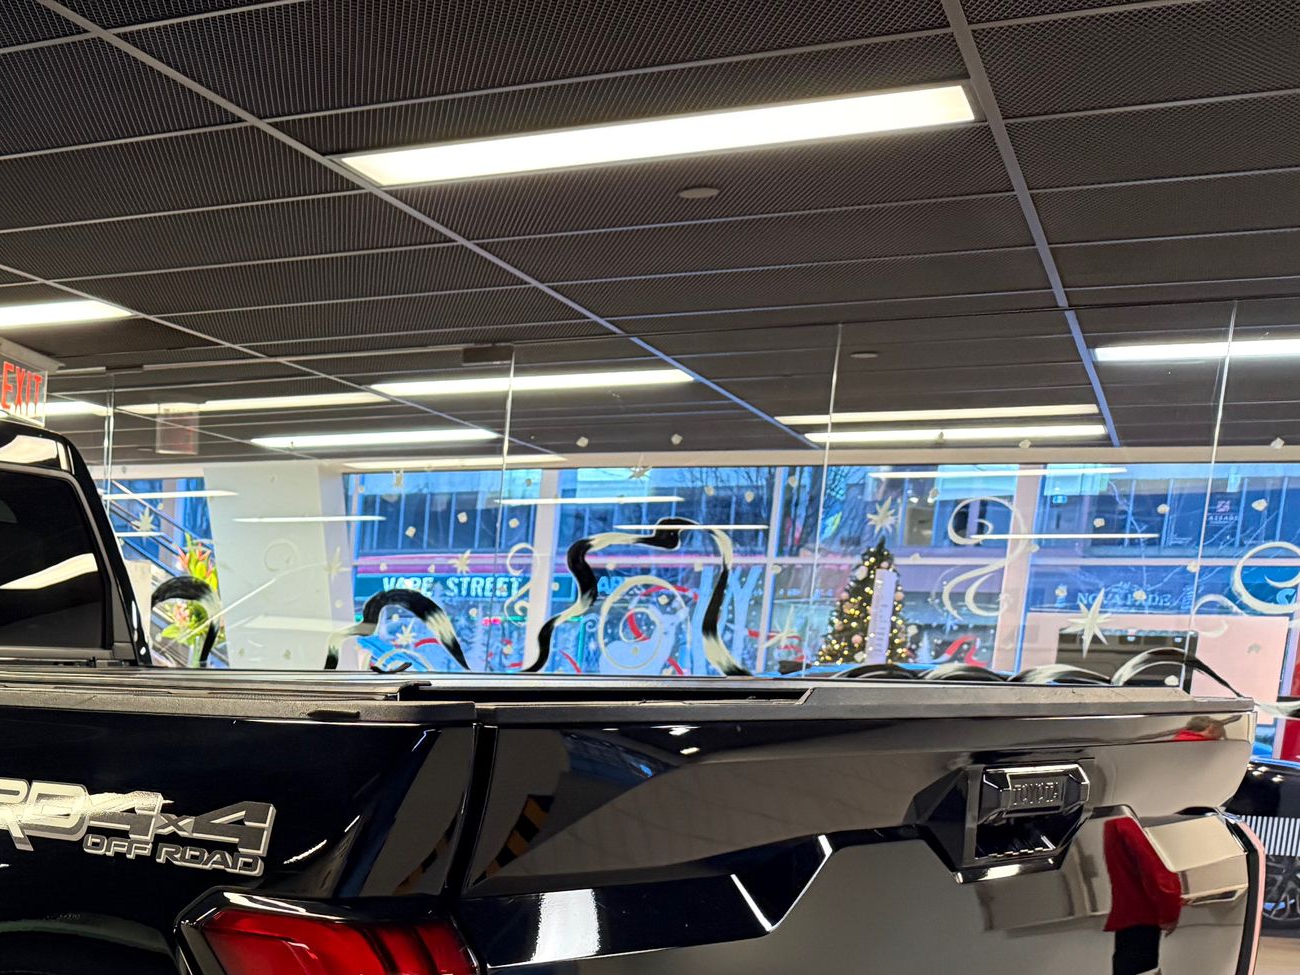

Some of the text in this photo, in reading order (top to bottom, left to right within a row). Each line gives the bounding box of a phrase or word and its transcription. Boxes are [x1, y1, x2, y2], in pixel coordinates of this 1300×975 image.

[2, 361, 42, 416] EXIT
[382, 576, 522, 598] VAPE STREET
[1012, 781, 1059, 805] TOYOTA
[86, 791, 276, 857] 4x4
[83, 834, 264, 877] OFF ROAD
